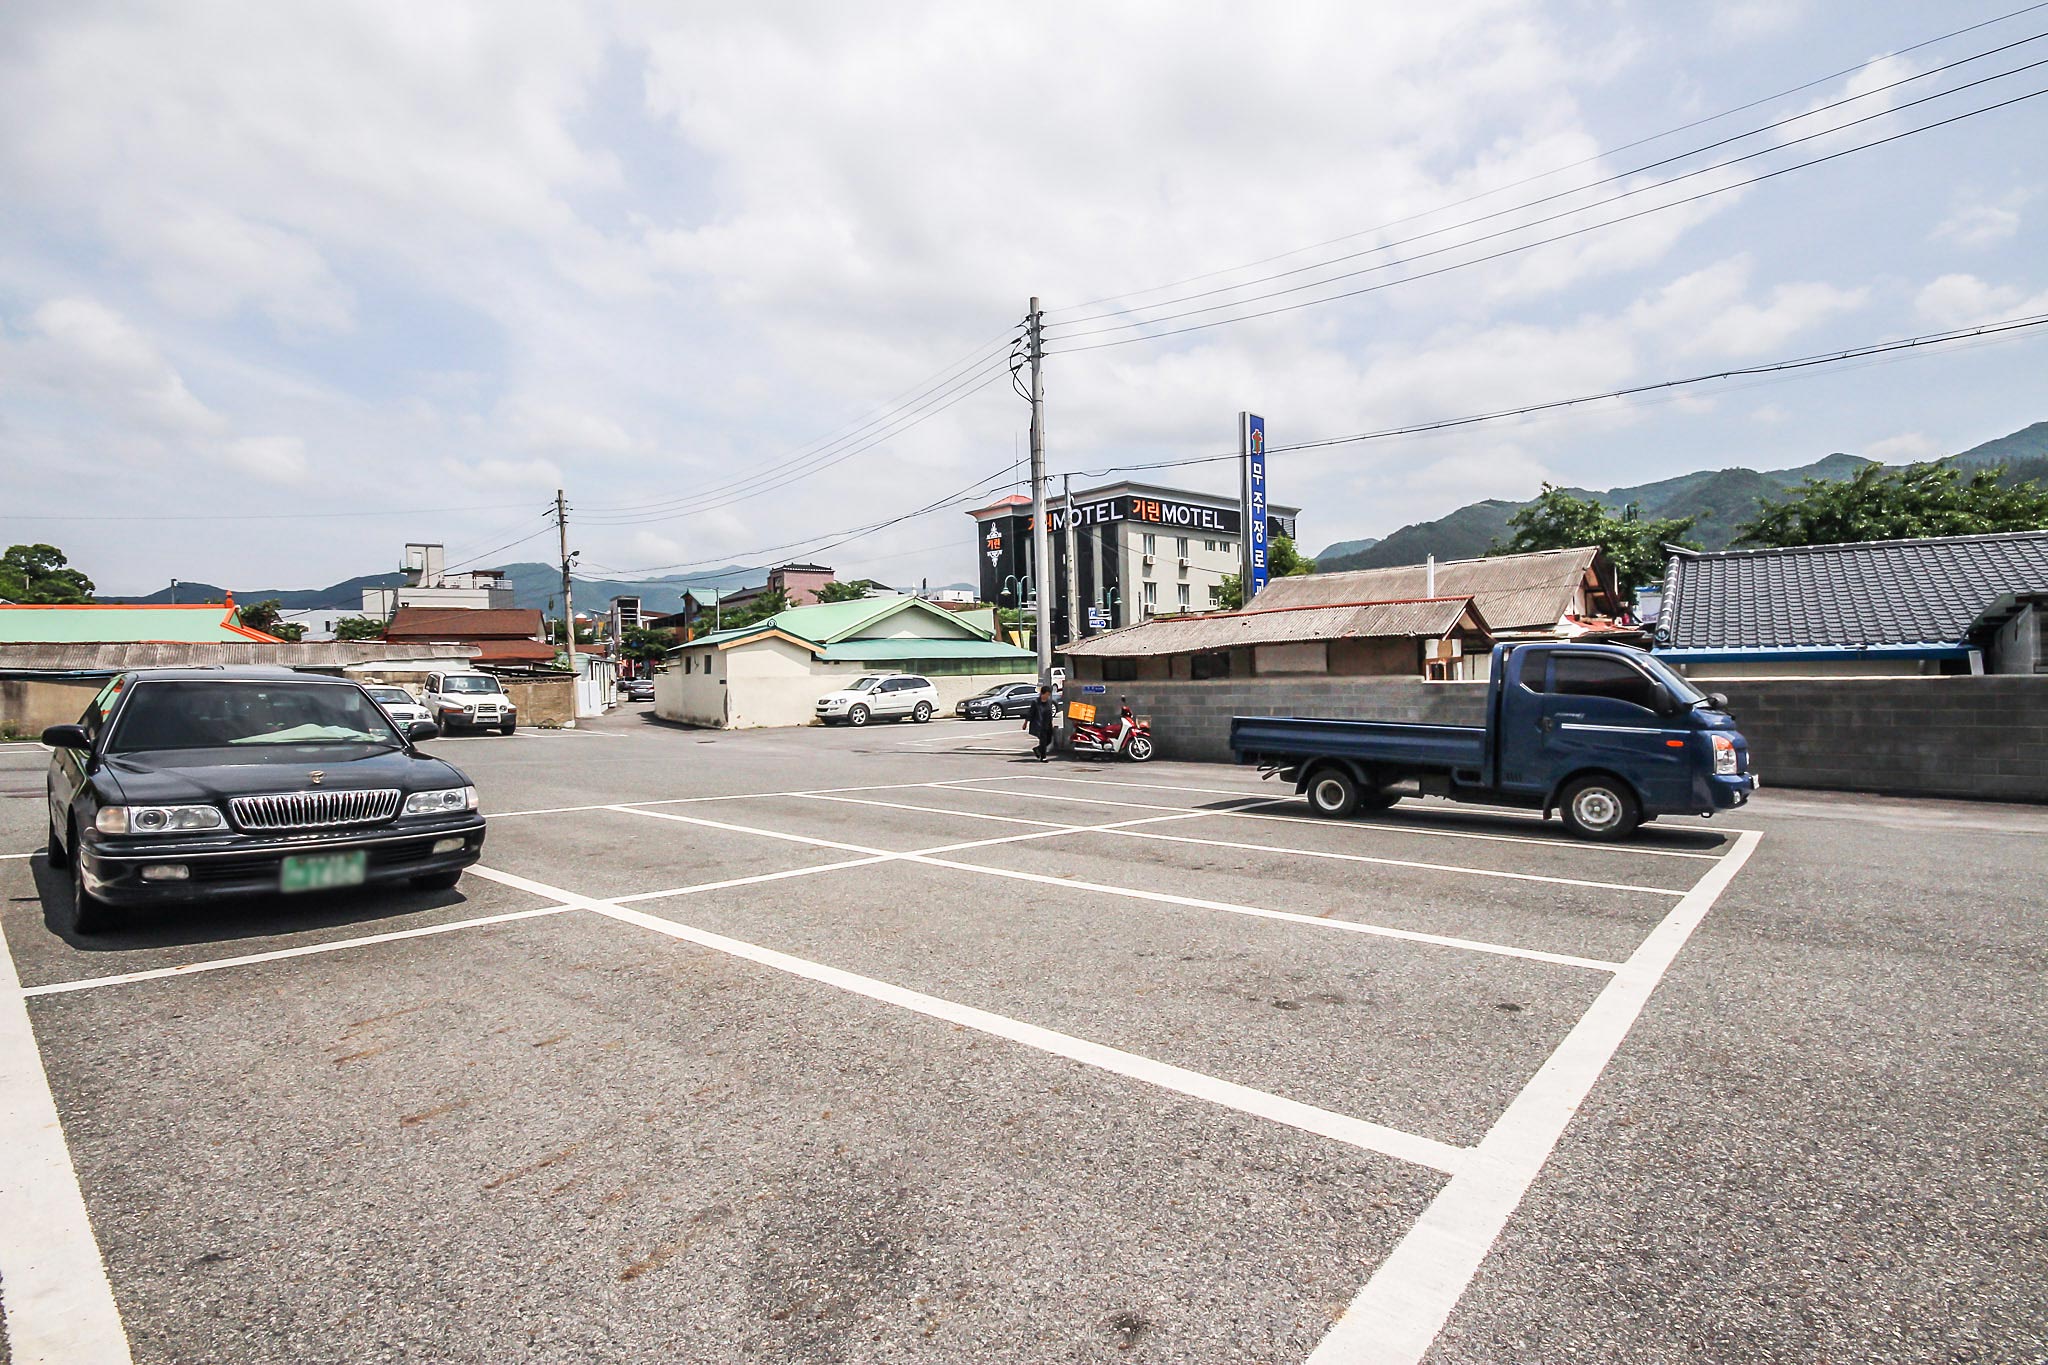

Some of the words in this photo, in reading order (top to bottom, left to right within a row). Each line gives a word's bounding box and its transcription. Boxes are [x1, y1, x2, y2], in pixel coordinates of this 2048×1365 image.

[1053, 501, 1124, 531] MOTEL
[1162, 503, 1225, 530] MOTEL
[986, 537, 1001, 550] 기린
